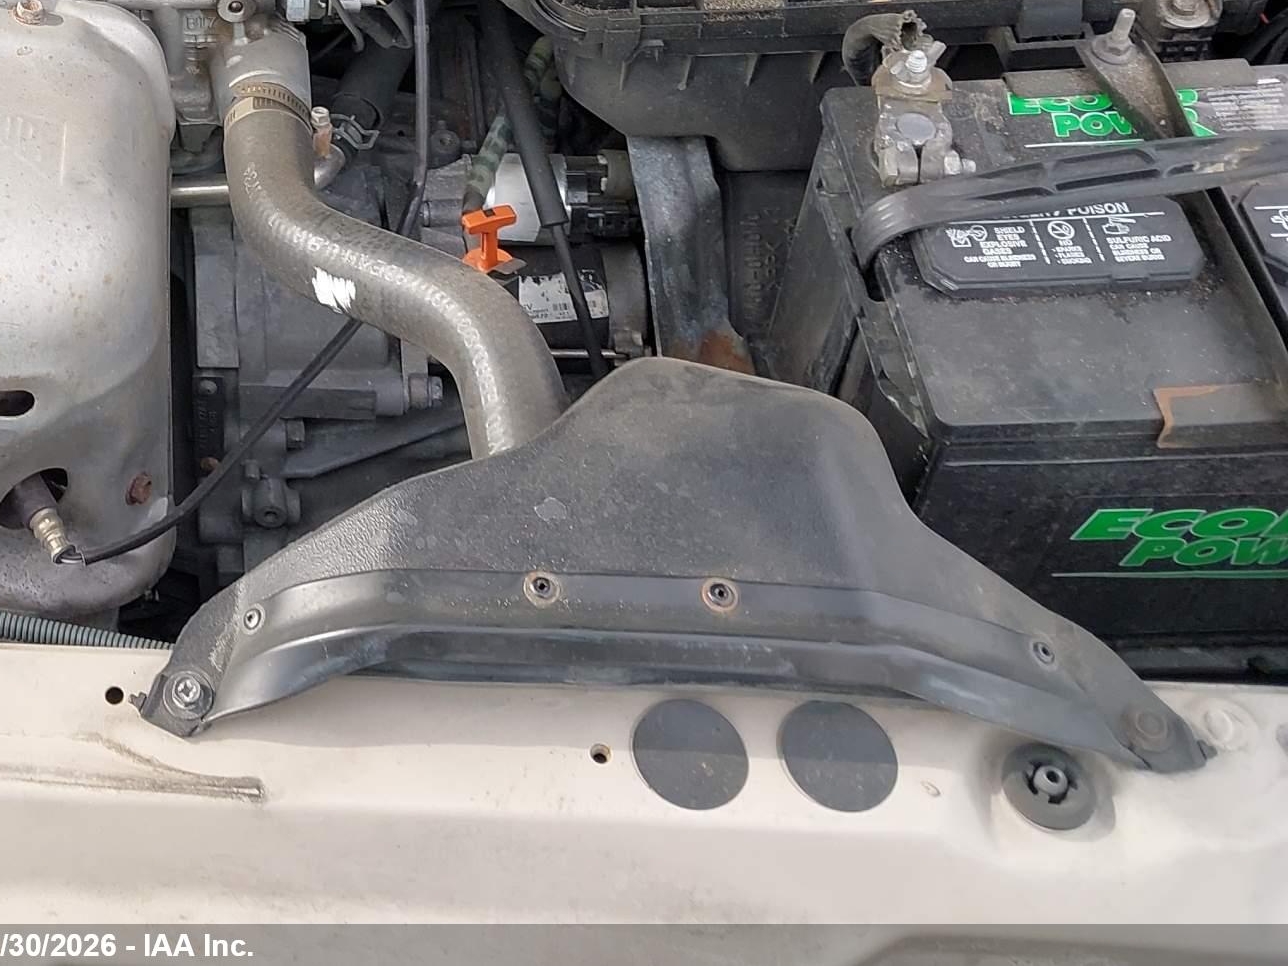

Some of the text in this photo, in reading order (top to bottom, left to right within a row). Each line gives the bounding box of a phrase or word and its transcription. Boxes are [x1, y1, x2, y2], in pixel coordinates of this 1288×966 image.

[994, 226, 1025, 235] SHIELD
[1106, 234, 1172, 244] SULFURIC ACID
[979, 240, 1028, 248] EXPLOSIVE
[1069, 508, 1288, 540] ECO
